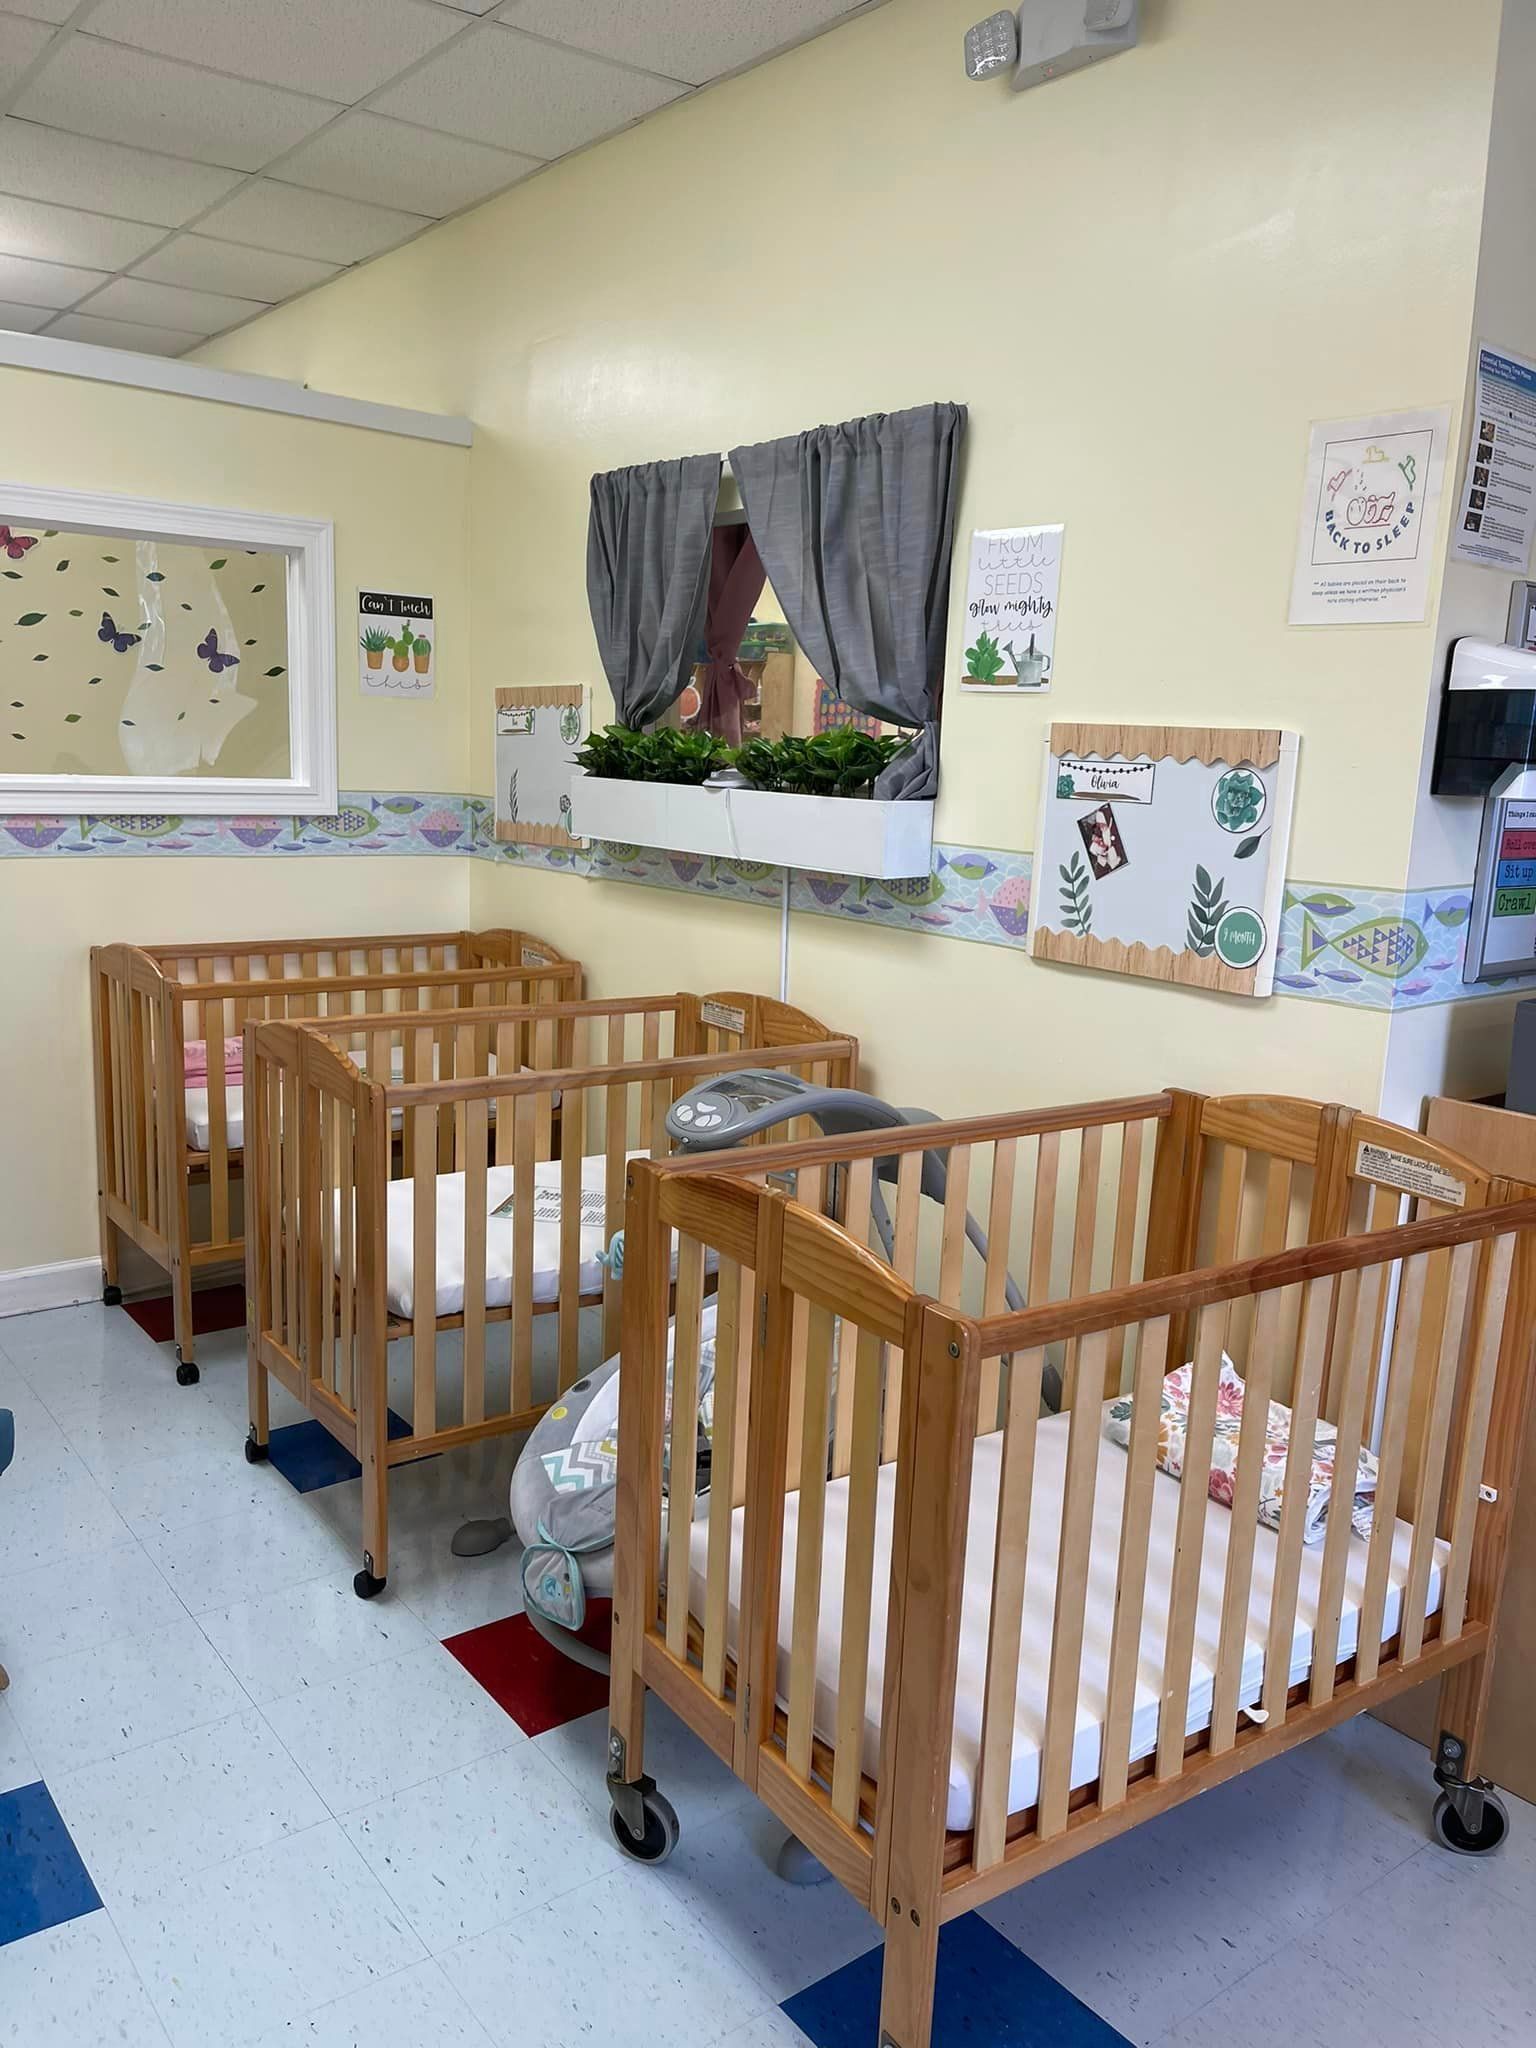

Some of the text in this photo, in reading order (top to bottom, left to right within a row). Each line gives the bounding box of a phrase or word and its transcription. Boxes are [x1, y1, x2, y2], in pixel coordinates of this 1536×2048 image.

[1325, 502, 1414, 555] BACK TO SLEEP
[987, 532, 1044, 554] FROM
[978, 555, 1055, 571] little
[984, 571, 1043, 596] SEEDS
[969, 596, 1054, 618] grow mighty
[363, 672, 431, 689] this
[1090, 774, 1121, 791] Olivia
[1504, 864, 1534, 882] Sit up
[1498, 893, 1532, 912] Crawl
